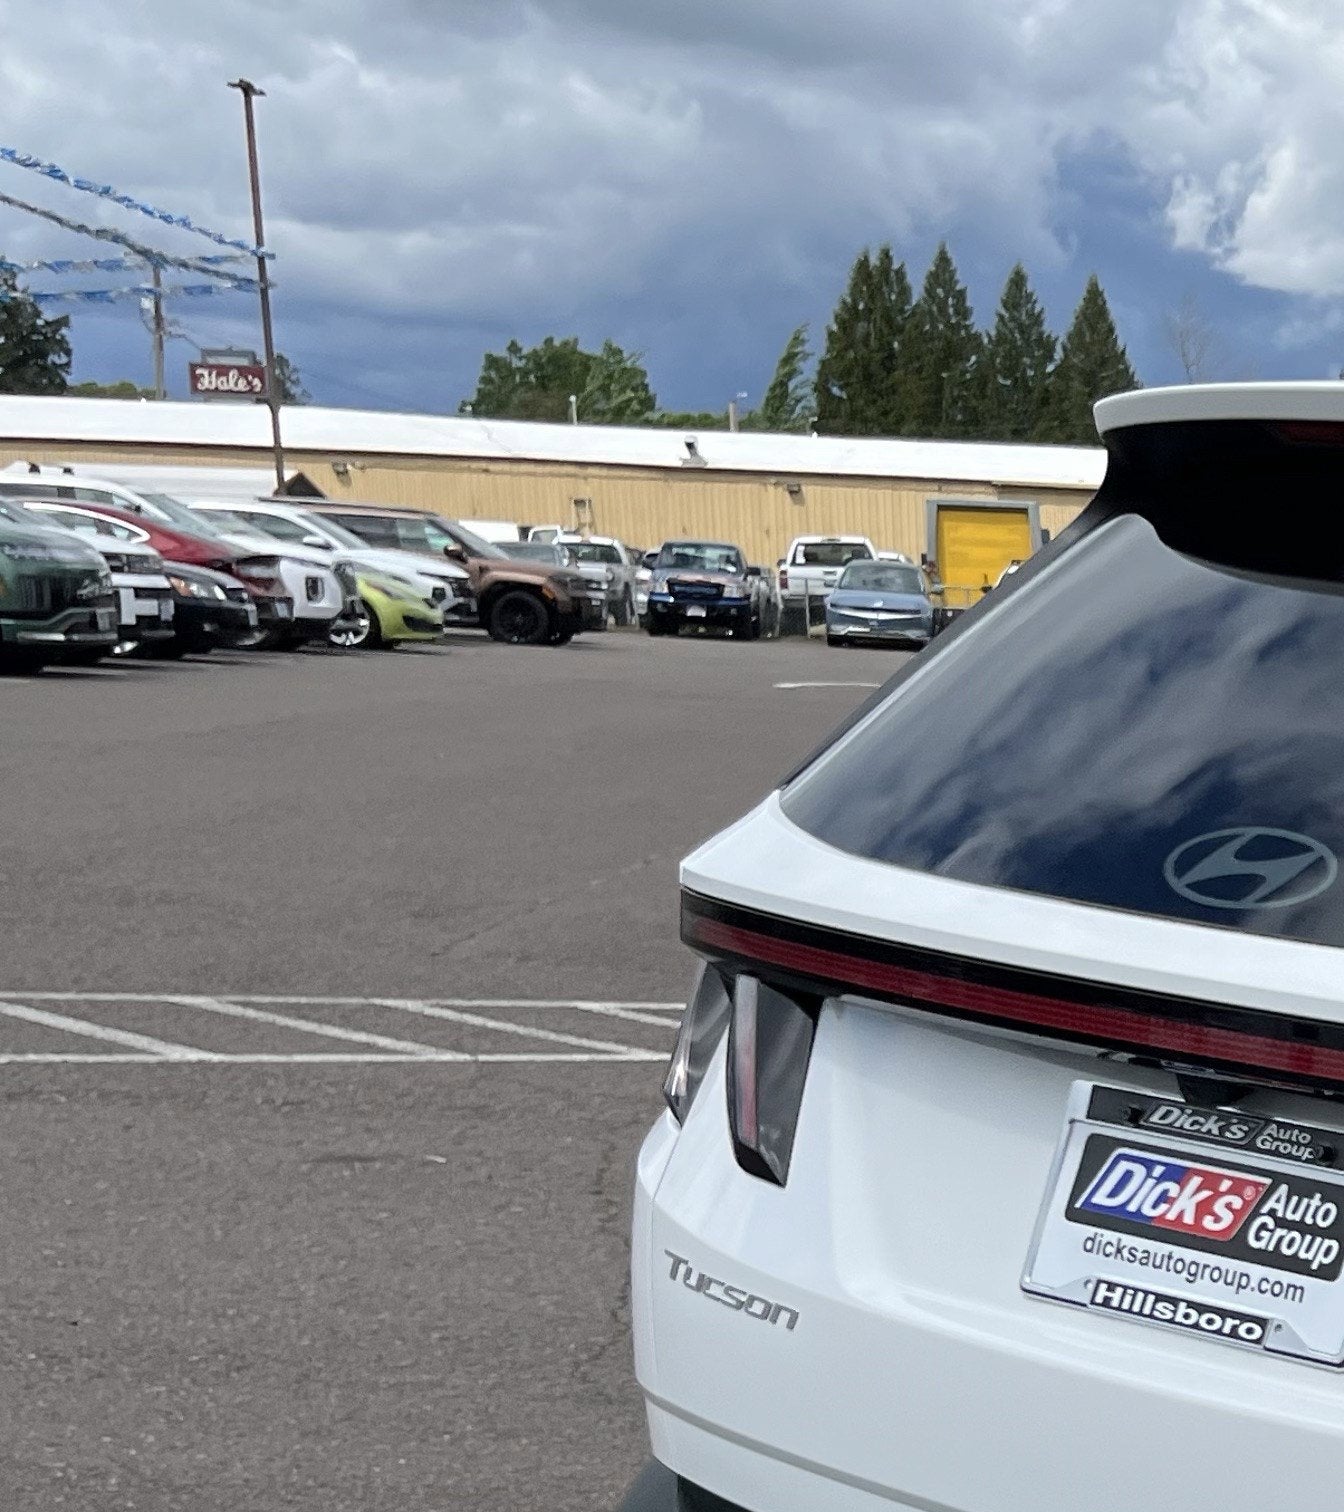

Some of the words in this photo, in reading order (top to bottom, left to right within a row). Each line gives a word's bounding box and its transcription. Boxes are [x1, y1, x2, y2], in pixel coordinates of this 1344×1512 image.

[1149, 1104, 1250, 1140] Dick's
[1262, 1122, 1312, 1145] Auto
[1090, 1159, 1244, 1232] Dick's
[1260, 1183, 1338, 1229] Auto
[1082, 1232, 1306, 1304] dicksautogroup.com
[1247, 1214, 1341, 1271] Group
[1093, 1281, 1264, 1341] Hillsboro
